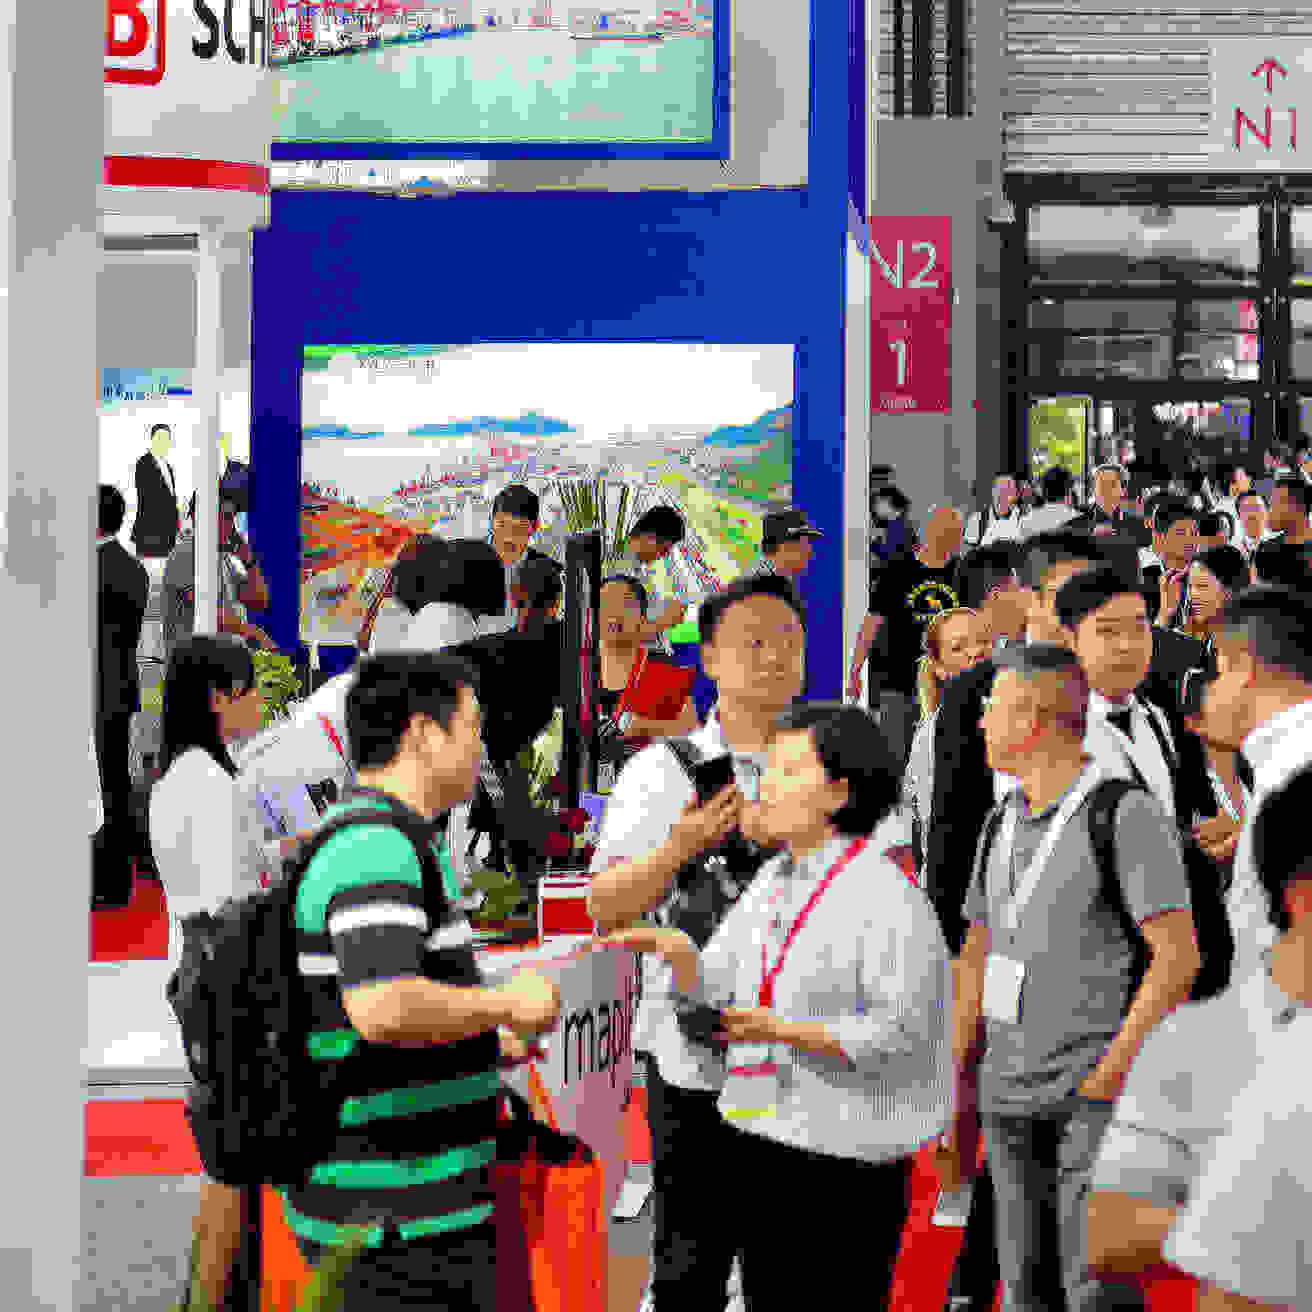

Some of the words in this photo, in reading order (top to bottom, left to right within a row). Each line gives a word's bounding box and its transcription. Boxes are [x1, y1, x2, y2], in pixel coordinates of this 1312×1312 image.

[1232, 103, 1297, 153] N1
[868, 240, 938, 288] N2
[888, 336, 906, 385] 1
